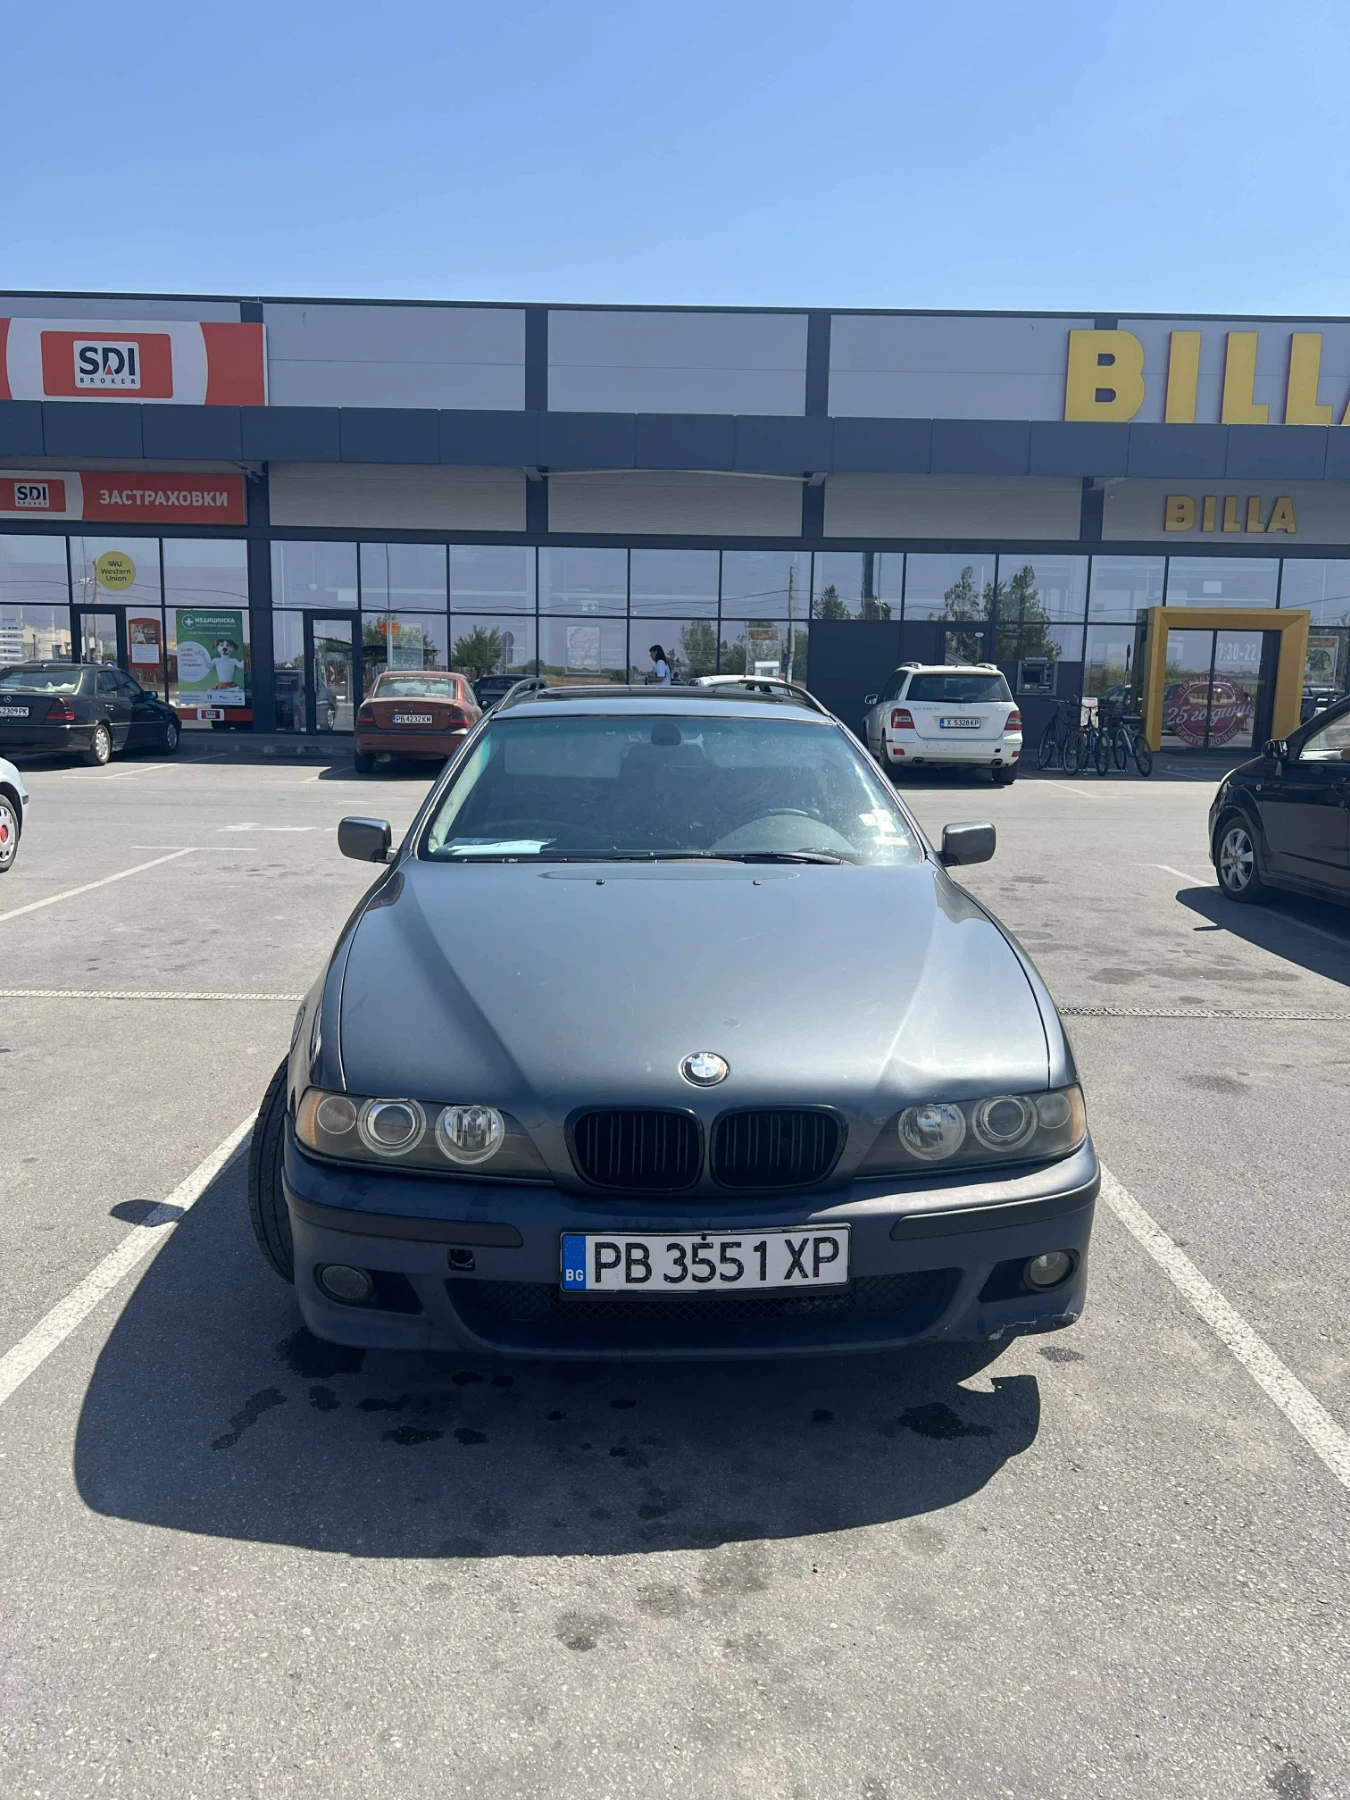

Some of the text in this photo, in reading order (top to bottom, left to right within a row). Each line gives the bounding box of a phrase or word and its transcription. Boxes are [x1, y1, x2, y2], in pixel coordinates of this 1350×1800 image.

[78, 346, 136, 376] SDI
[79, 377, 136, 385] BROKER
[1063, 329, 1350, 425] BILL
[17, 486, 47, 501] SDI
[99, 489, 228, 507] ЗАСТРАХОВКИ
[1164, 495, 1297, 534] BILLA
[1166, 705, 1191, 726] 25
[1175, 726, 1203, 746] ВИНАГИ
[565, 1236, 840, 1284] BG PB 3551 XP
